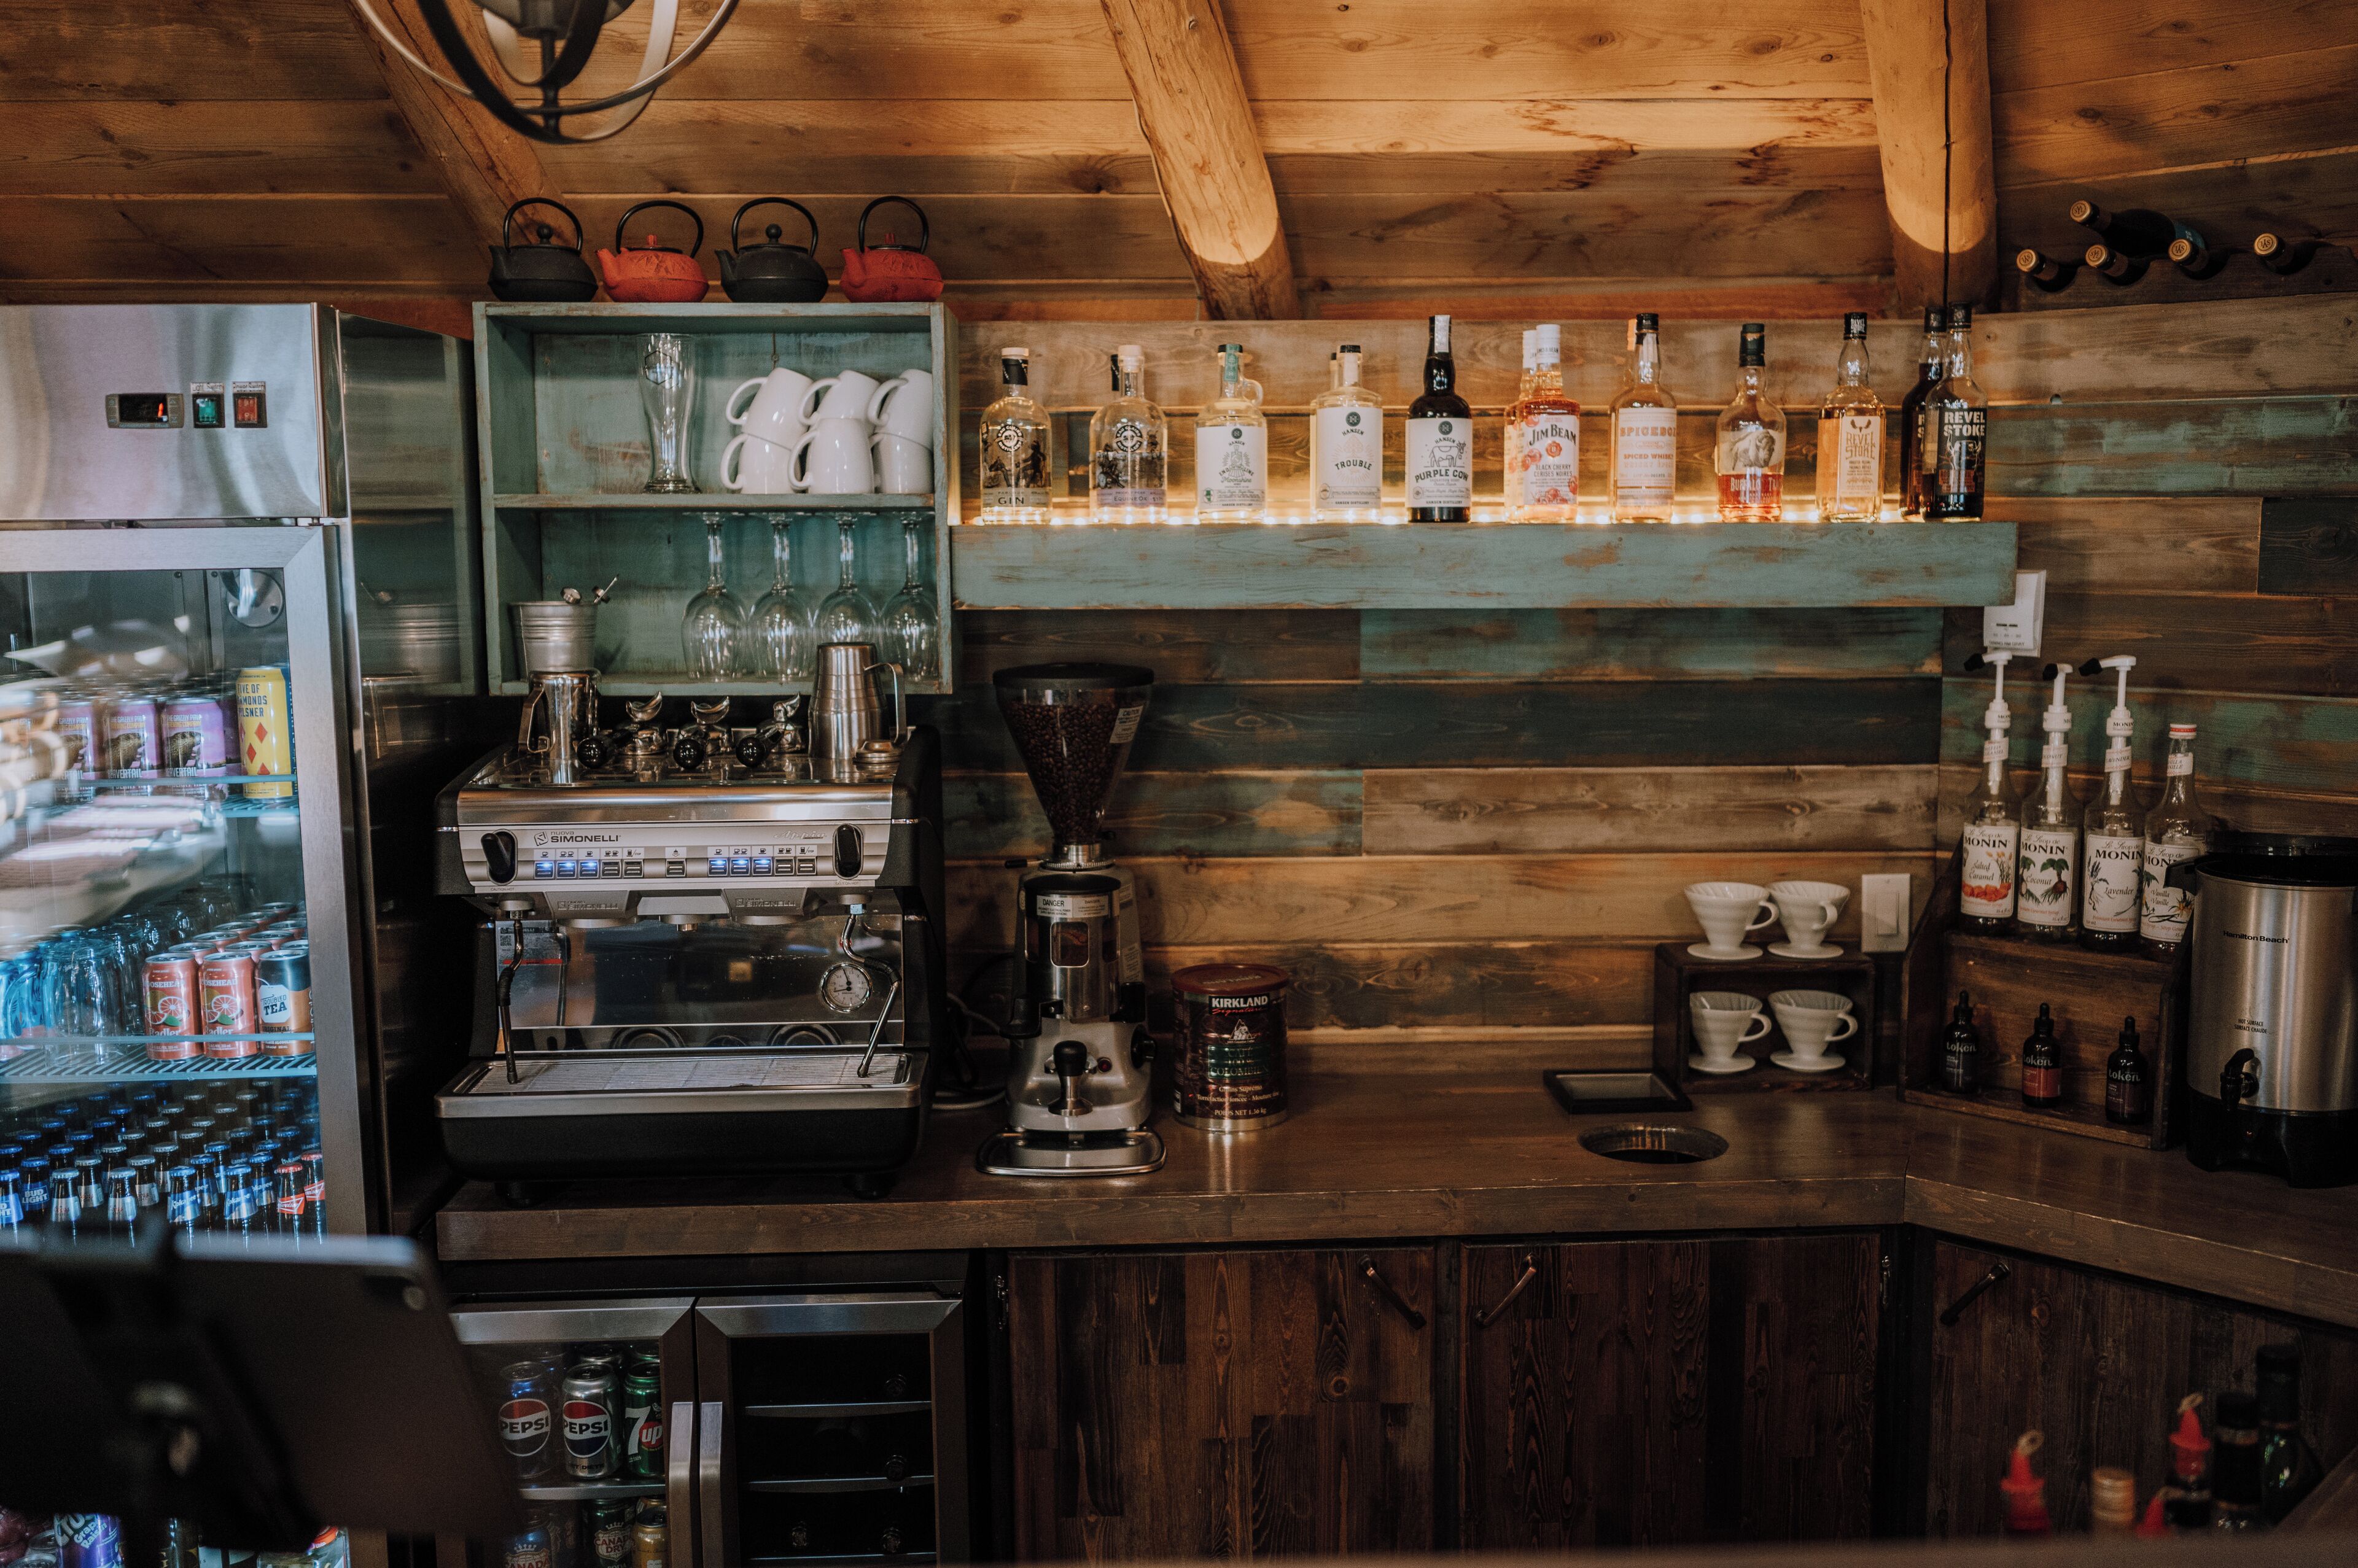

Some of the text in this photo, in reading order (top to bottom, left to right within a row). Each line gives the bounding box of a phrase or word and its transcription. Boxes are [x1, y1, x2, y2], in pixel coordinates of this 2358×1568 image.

[1944, 411, 1985, 424] REVEL
[1529, 424, 1576, 446] JIM BEAM
[1944, 424, 1985, 437] STOKE
[1846, 432, 1876, 448] REVEL
[1845, 444, 1876, 460] STOKE
[1334, 459, 1372, 470] TROUBLE
[1415, 468, 1469, 483] PURPLE COW
[998, 496, 1024, 505] GIN
[251, 683, 260, 693] OF
[774, 830, 827, 840] Appia
[1965, 836, 2008, 848] MONIN
[2103, 840, 2114, 848] Le
[2114, 841, 2133, 852] Sirop
[2021, 842, 2065, 855] MONIN
[2095, 849, 2142, 860] MONIN
[2156, 848, 2174, 859] Sirop
[1971, 860, 1991, 872] Salted
[2146, 854, 2177, 867] MON
[1969, 870, 1994, 881] Caramel
[2026, 874, 2052, 885] Coconut
[2104, 886, 2134, 899] Lavender
[2151, 888, 2170, 898] Vanilla
[2150, 898, 2169, 906] Vanille
[2223, 930, 2259, 941] Hamilton
[261, 994, 287, 1006] TROUBLED
[1212, 995, 1268, 1008] KIRKLAND
[263, 1001, 287, 1016] TEA
[1211, 1006, 1267, 1017] Signature
[2235, 1023, 2251, 1032] SURFACE
[21, 1193, 48, 1203] LIGHT
[171, 1193, 196, 1209] Kokanee
[502, 1415, 549, 1435] PEPSI
[564, 1419, 609, 1435] PEPSI
[625, 1406, 663, 1456] 7 up
[73, 1521, 99, 1543] Grap
[605, 1545, 625, 1554] DRY
